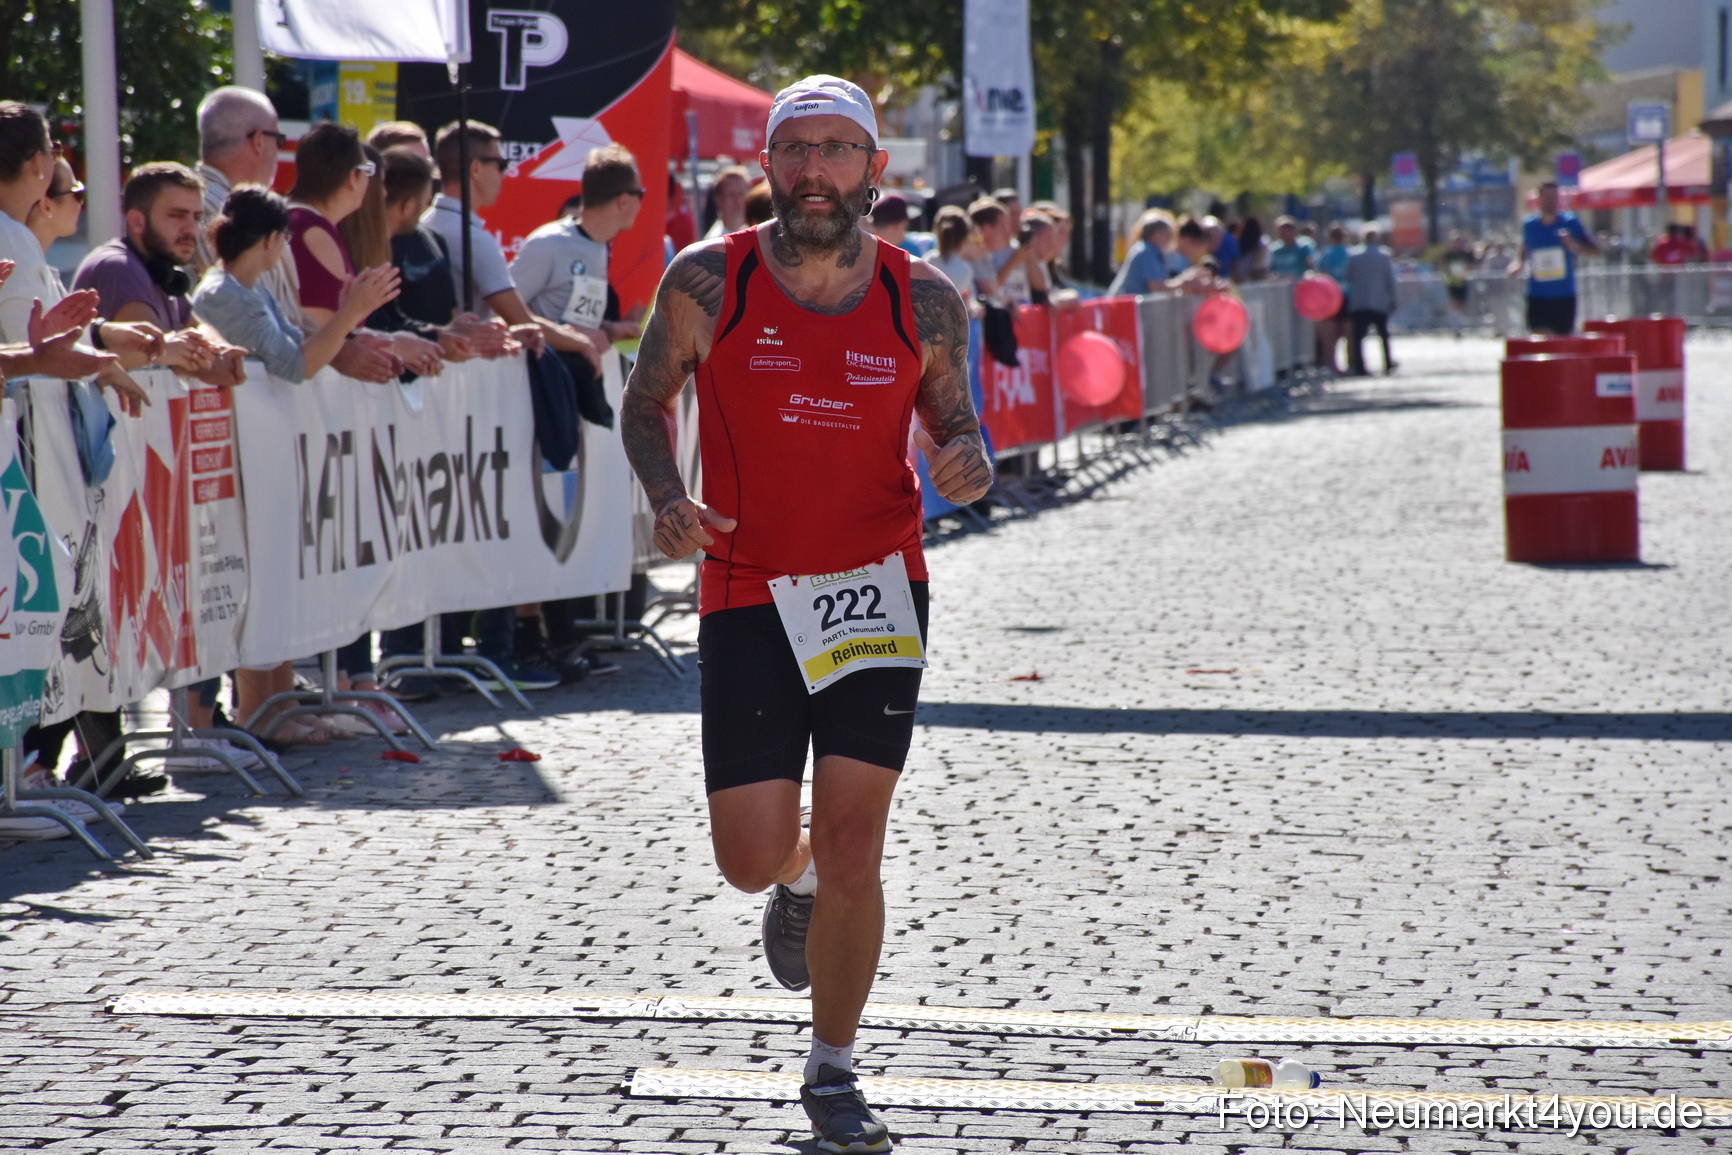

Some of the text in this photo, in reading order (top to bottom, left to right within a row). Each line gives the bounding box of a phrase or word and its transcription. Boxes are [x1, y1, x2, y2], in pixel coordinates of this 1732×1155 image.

[846, 350, 896, 368] HEINLOTH
[789, 393, 854, 410] Gruber
[813, 420, 861, 430] BADGESTALTER
[813, 584, 886, 632] 222
[822, 626, 884, 646] PARTL Neumarkt
[831, 640, 898, 666] Reinhard
